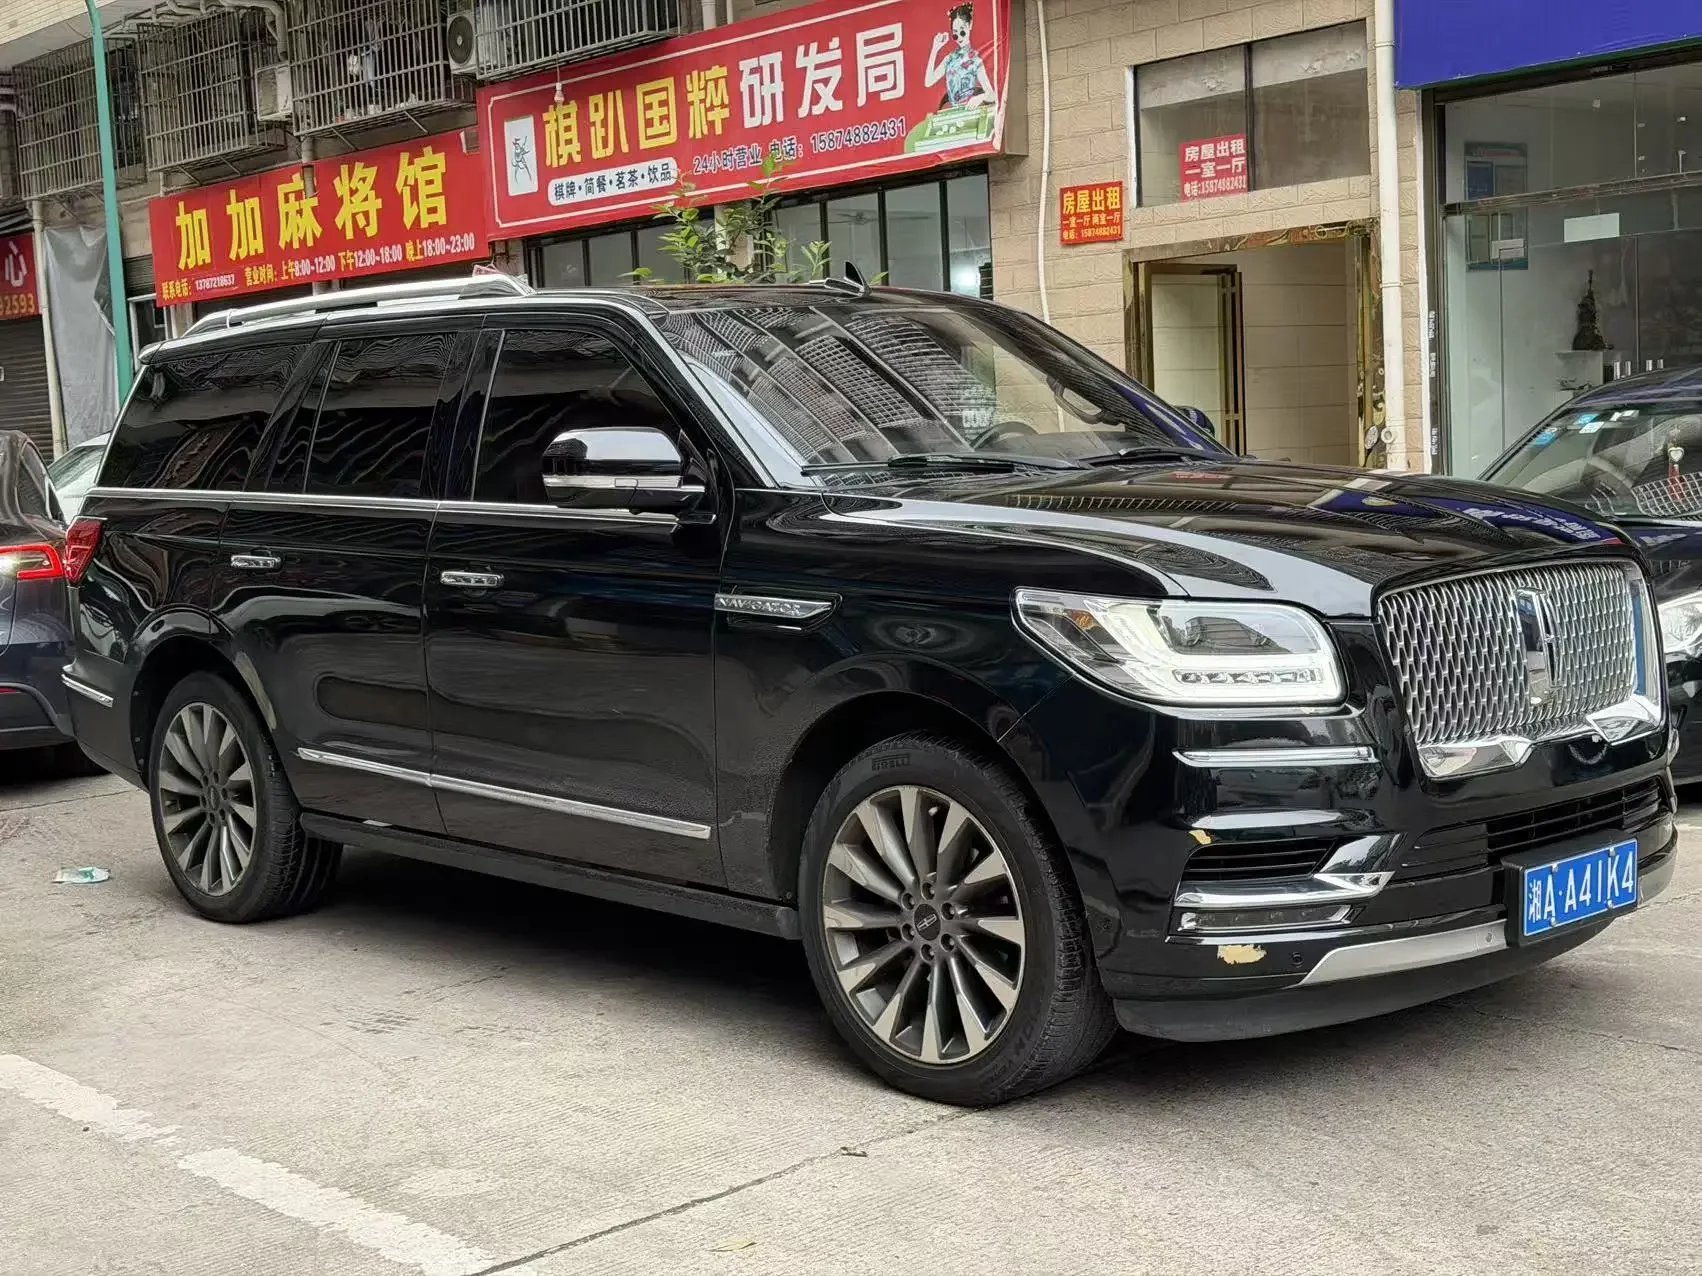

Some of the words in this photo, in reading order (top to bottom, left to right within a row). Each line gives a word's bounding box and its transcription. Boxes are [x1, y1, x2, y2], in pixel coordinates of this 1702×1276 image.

[543, 22, 905, 168] 棋趴国粹研发局
[693, 145, 763, 175] 24小时营业
[810, 116, 906, 153] 15874882431
[1185, 139, 1246, 162] 房屋出租
[1185, 157, 1246, 178] 一室一厅
[176, 146, 447, 271] 加加麻将馆
[1063, 187, 1120, 214] 房屋出租
